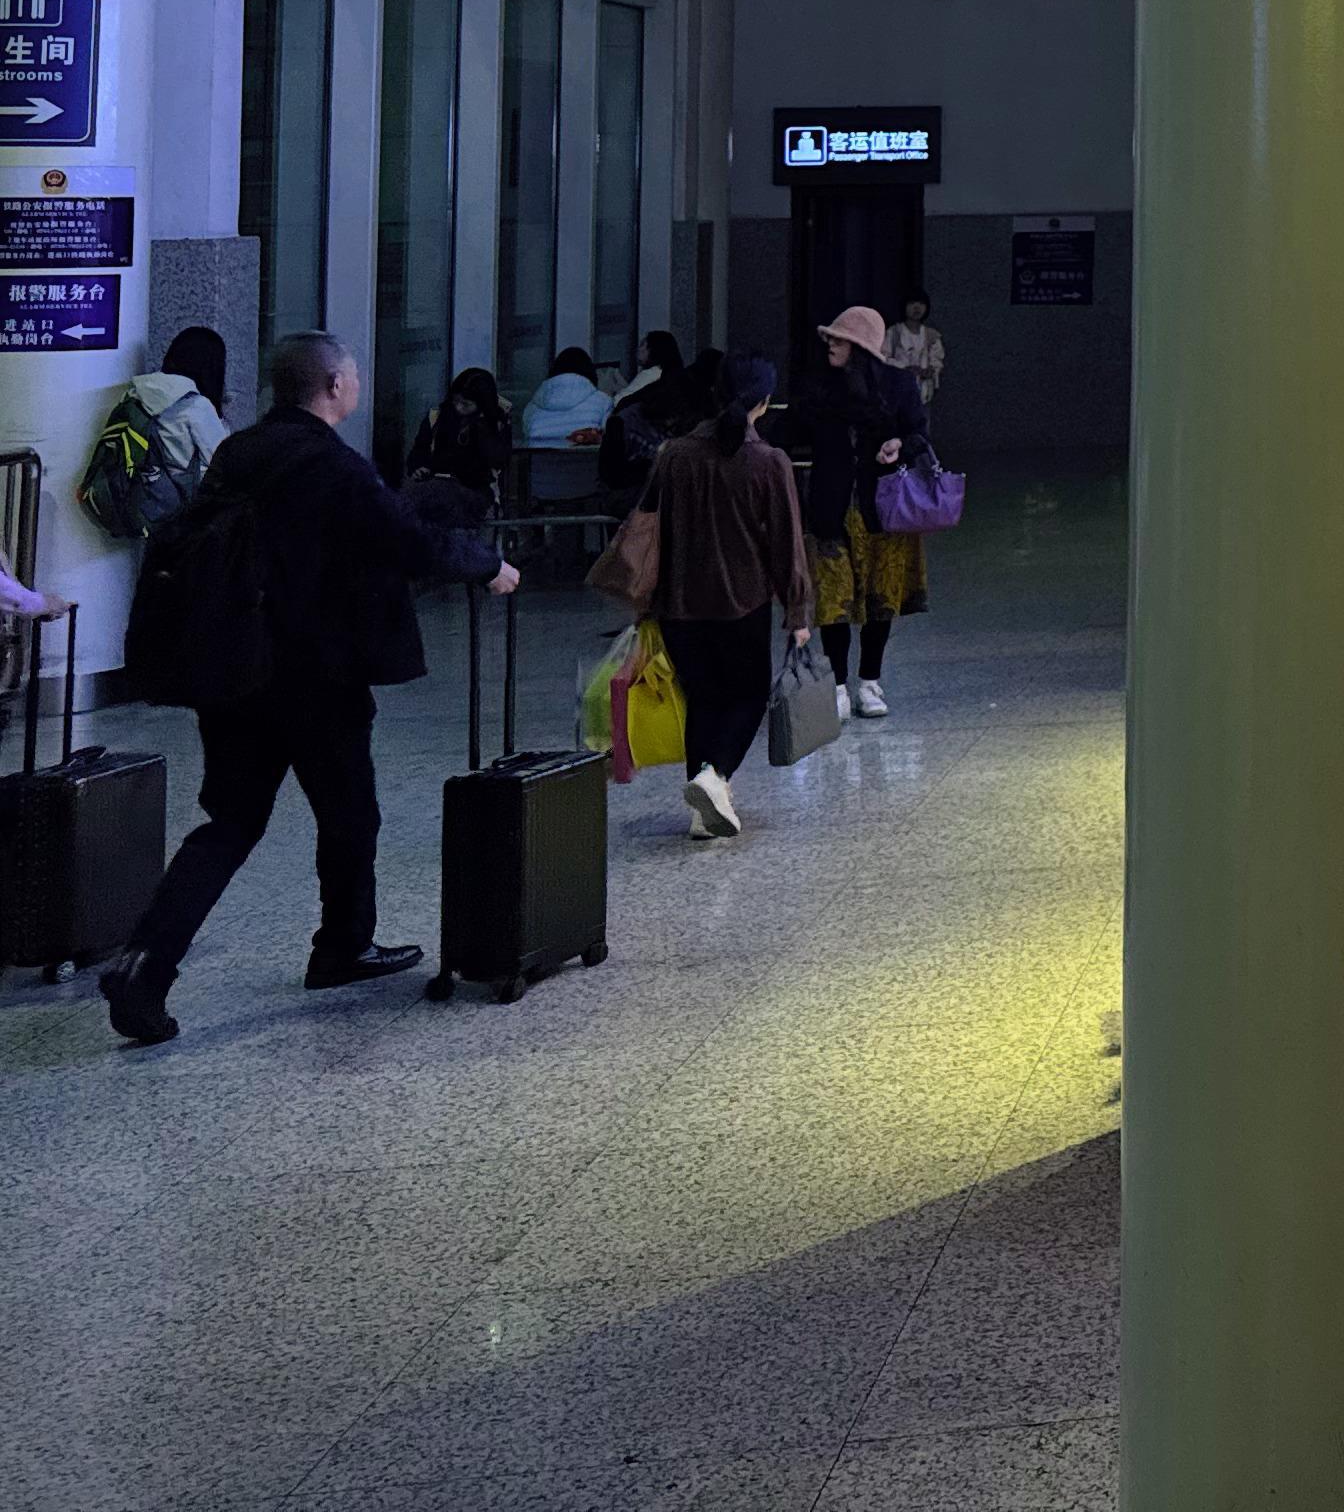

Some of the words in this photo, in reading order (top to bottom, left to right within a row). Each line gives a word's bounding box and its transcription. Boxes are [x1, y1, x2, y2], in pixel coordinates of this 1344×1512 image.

[829, 131, 929, 152] 客运值班室
[8, 283, 106, 302] 报警服务台
